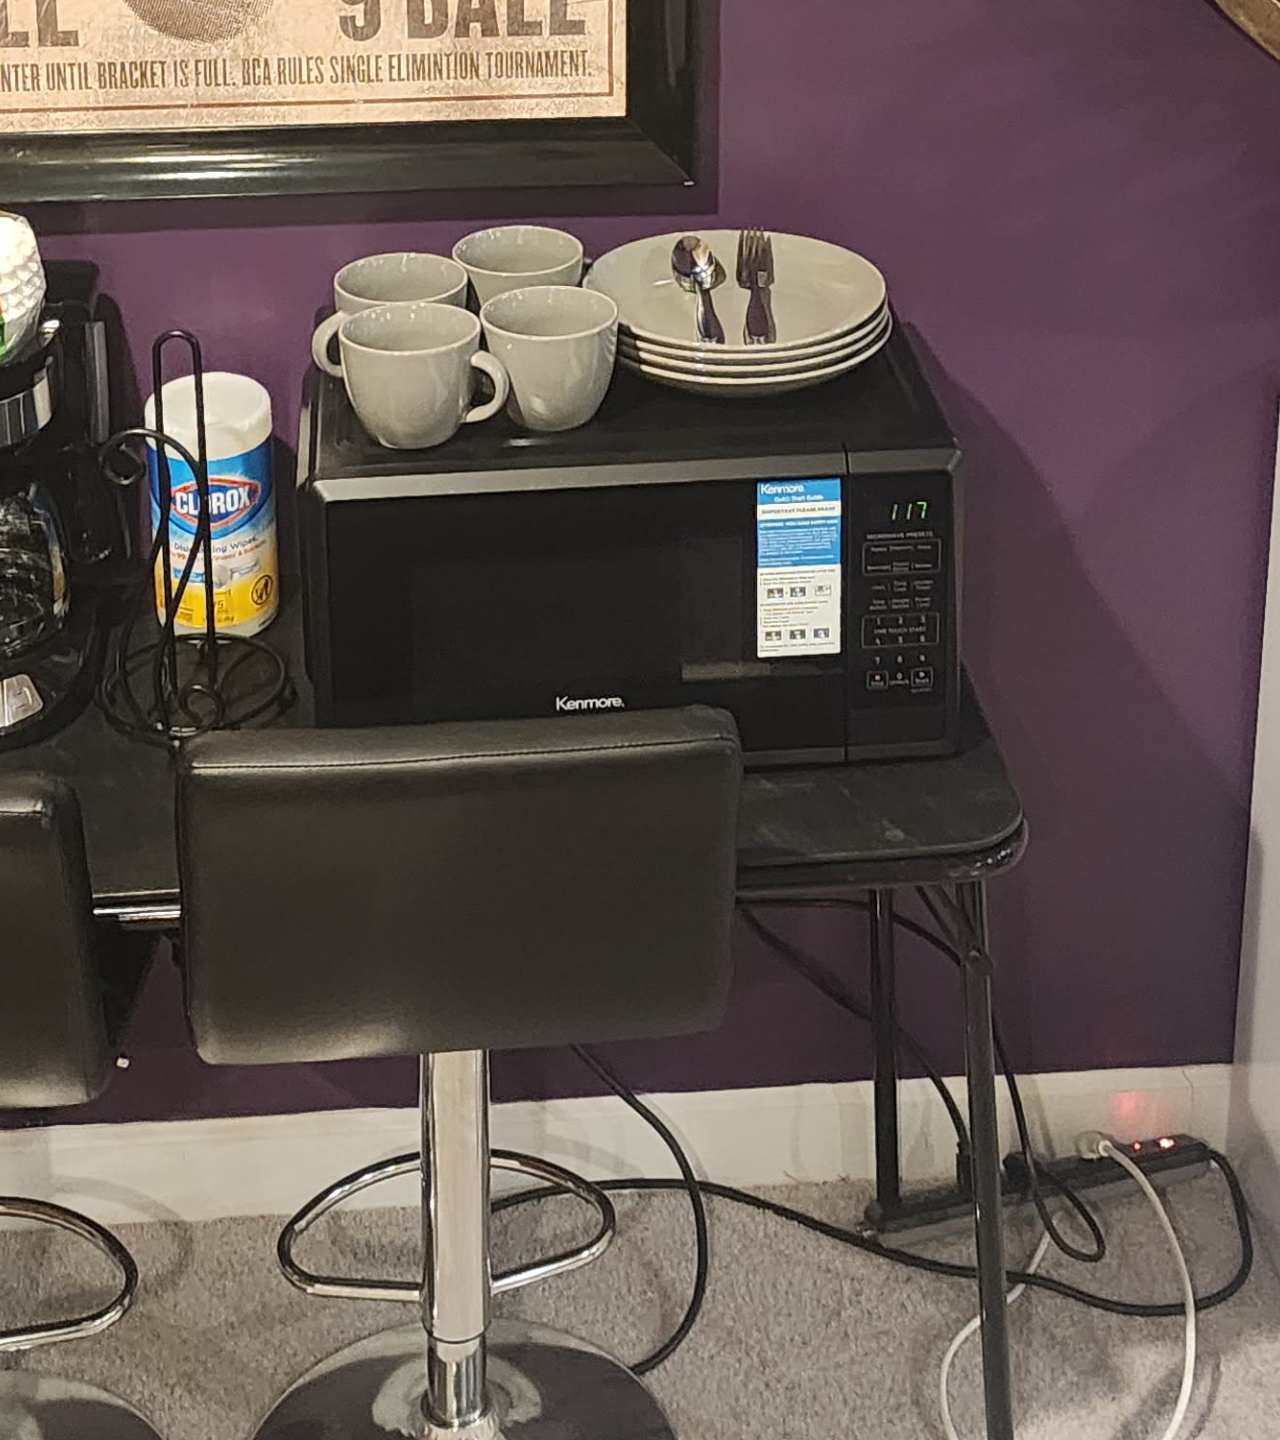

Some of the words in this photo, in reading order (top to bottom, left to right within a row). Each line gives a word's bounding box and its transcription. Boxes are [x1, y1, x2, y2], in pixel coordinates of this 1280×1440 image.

[46, 61, 93, 91] UNTIL
[98, 60, 167, 90] BRACKET
[173, 59, 189, 89] IS
[194, 59, 236, 88] FULL.
[242, 58, 272, 87] BCA
[277, 55, 325, 85] RULES
[330, 53, 383, 83] SINGLE
[485, 49, 593, 80] TOURNAMENT.
[761, 483, 805, 495] Kenmore
[555, 696, 623, 711] Kenmore
